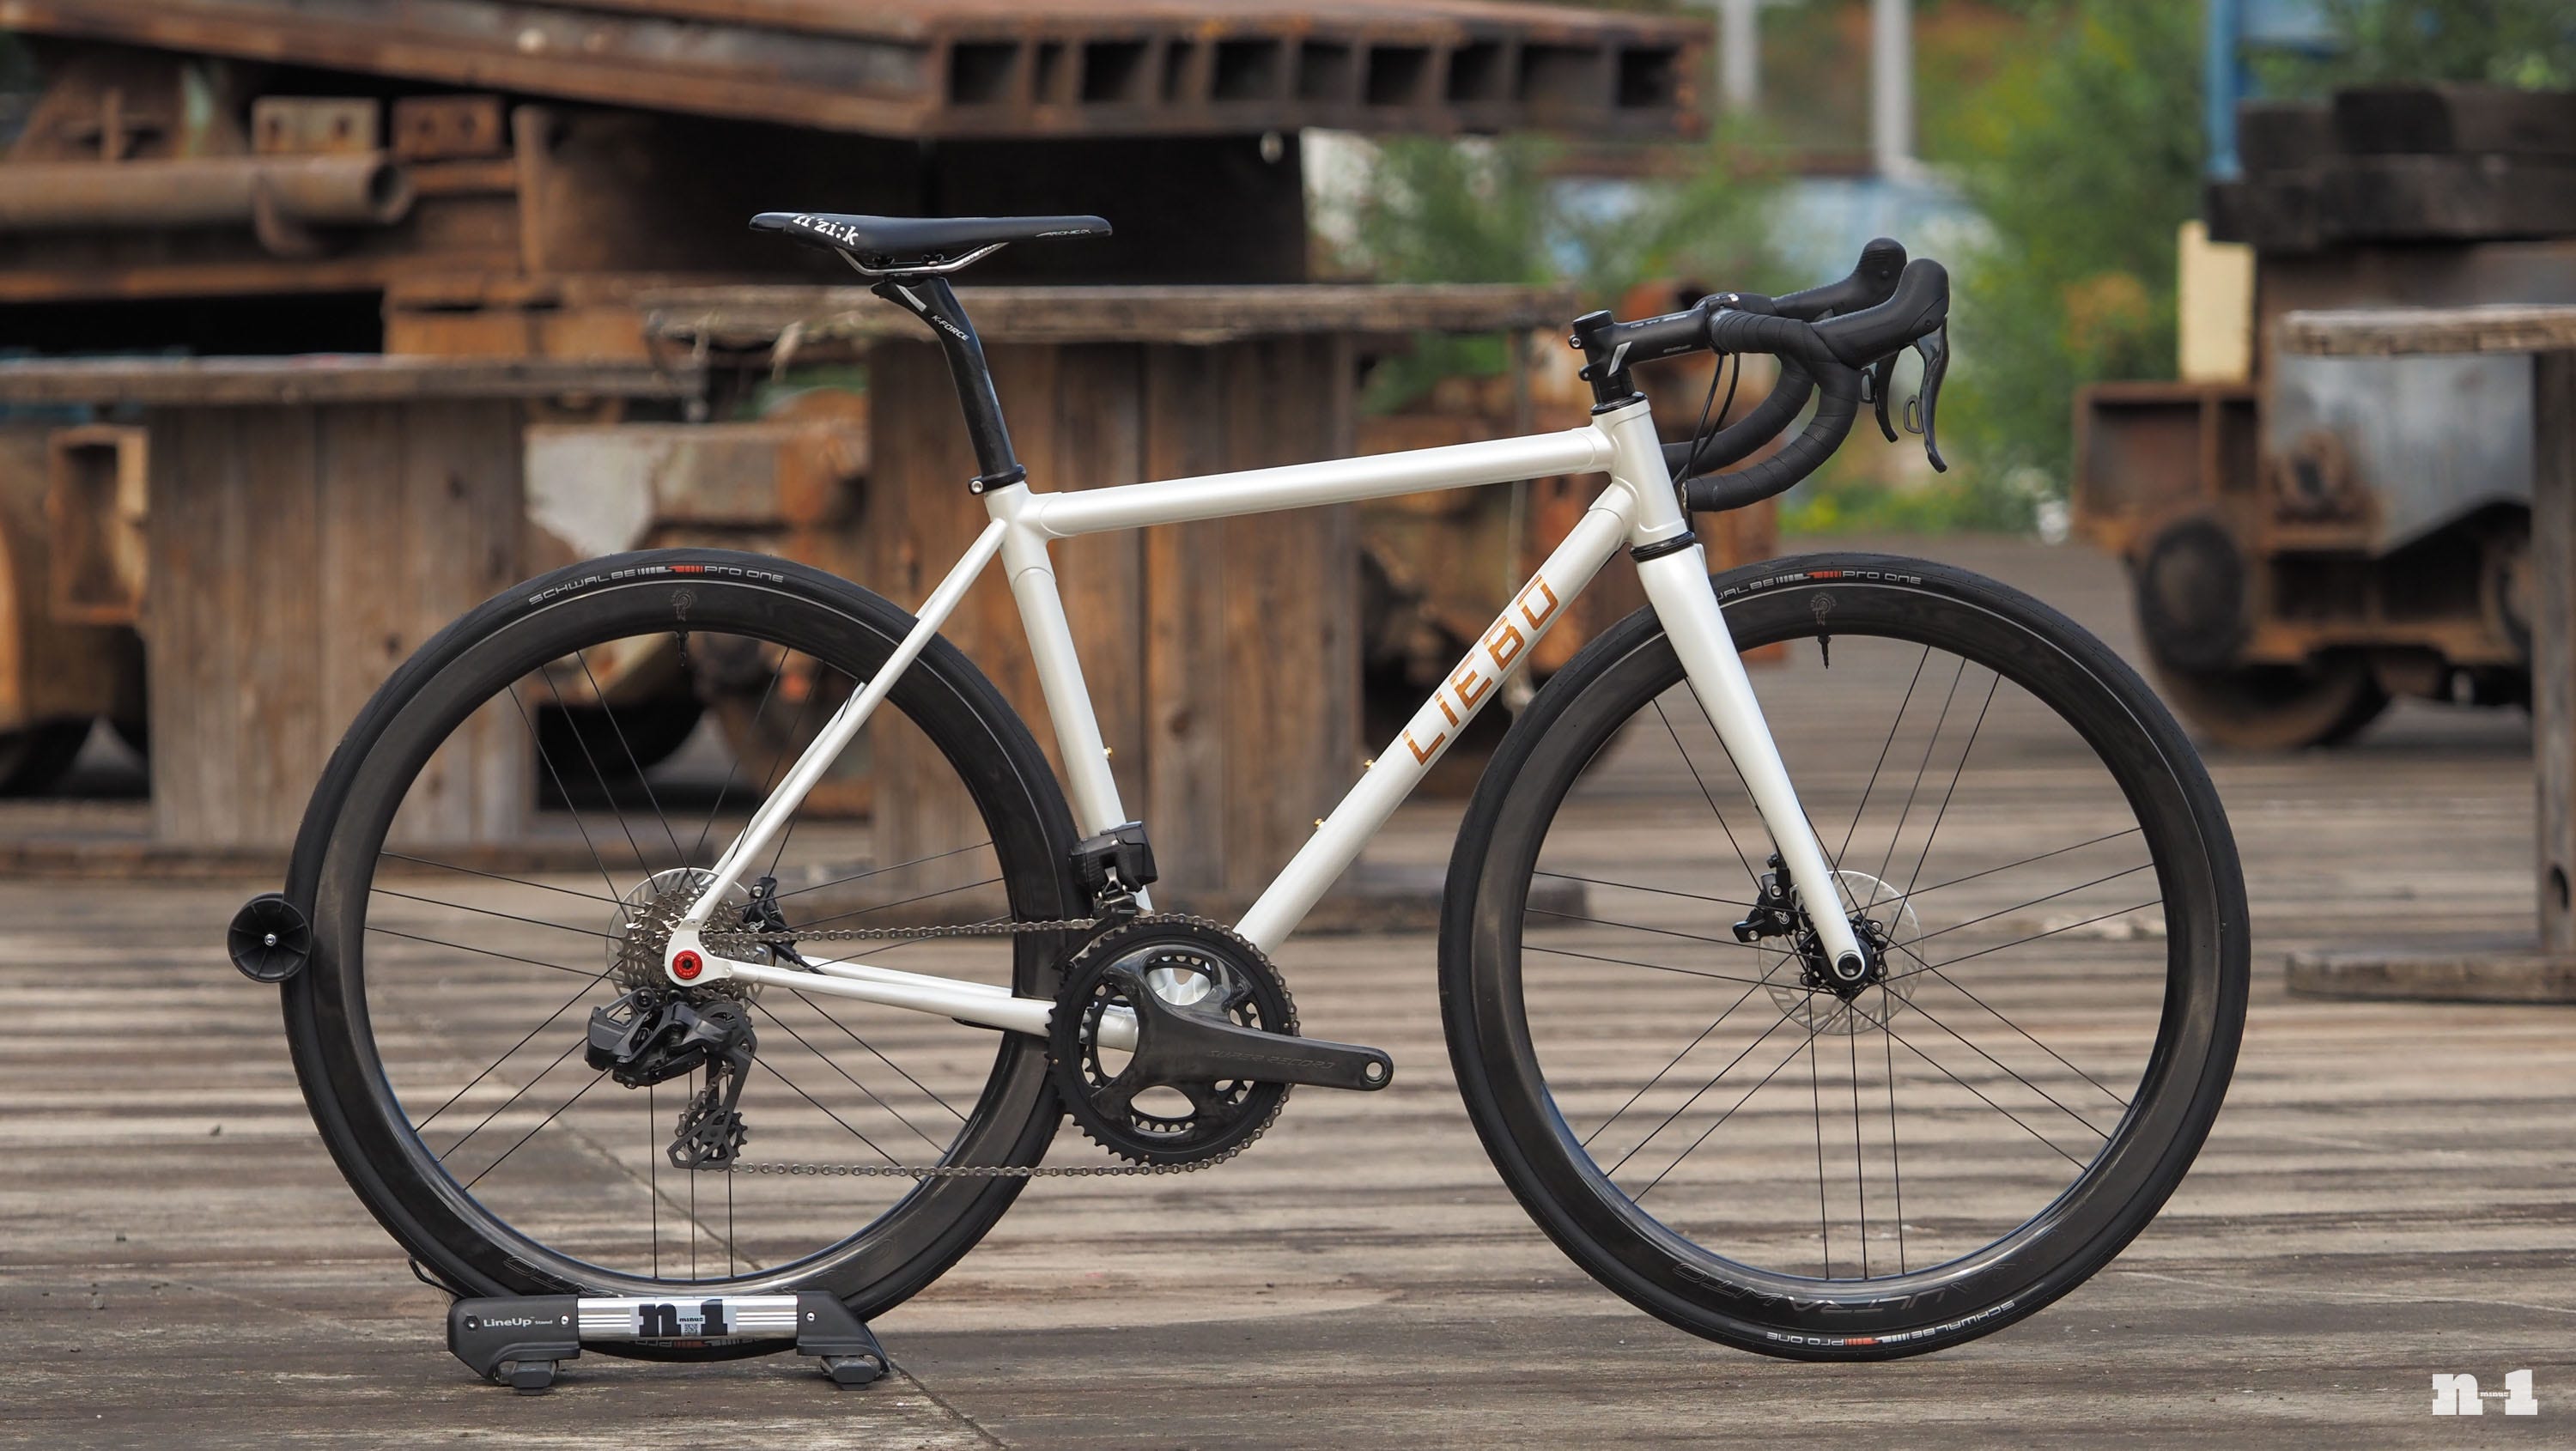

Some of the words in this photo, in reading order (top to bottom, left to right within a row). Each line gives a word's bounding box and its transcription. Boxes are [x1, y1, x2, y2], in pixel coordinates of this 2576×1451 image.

[932, 314, 970, 341] K-FORCE
[529, 568, 635, 604] SCHWALBE
[1402, 574, 1559, 766] LIEBO
[483, 1318, 532, 1327] LineUp
[1911, 1300, 2014, 1338] SCHWALBE
